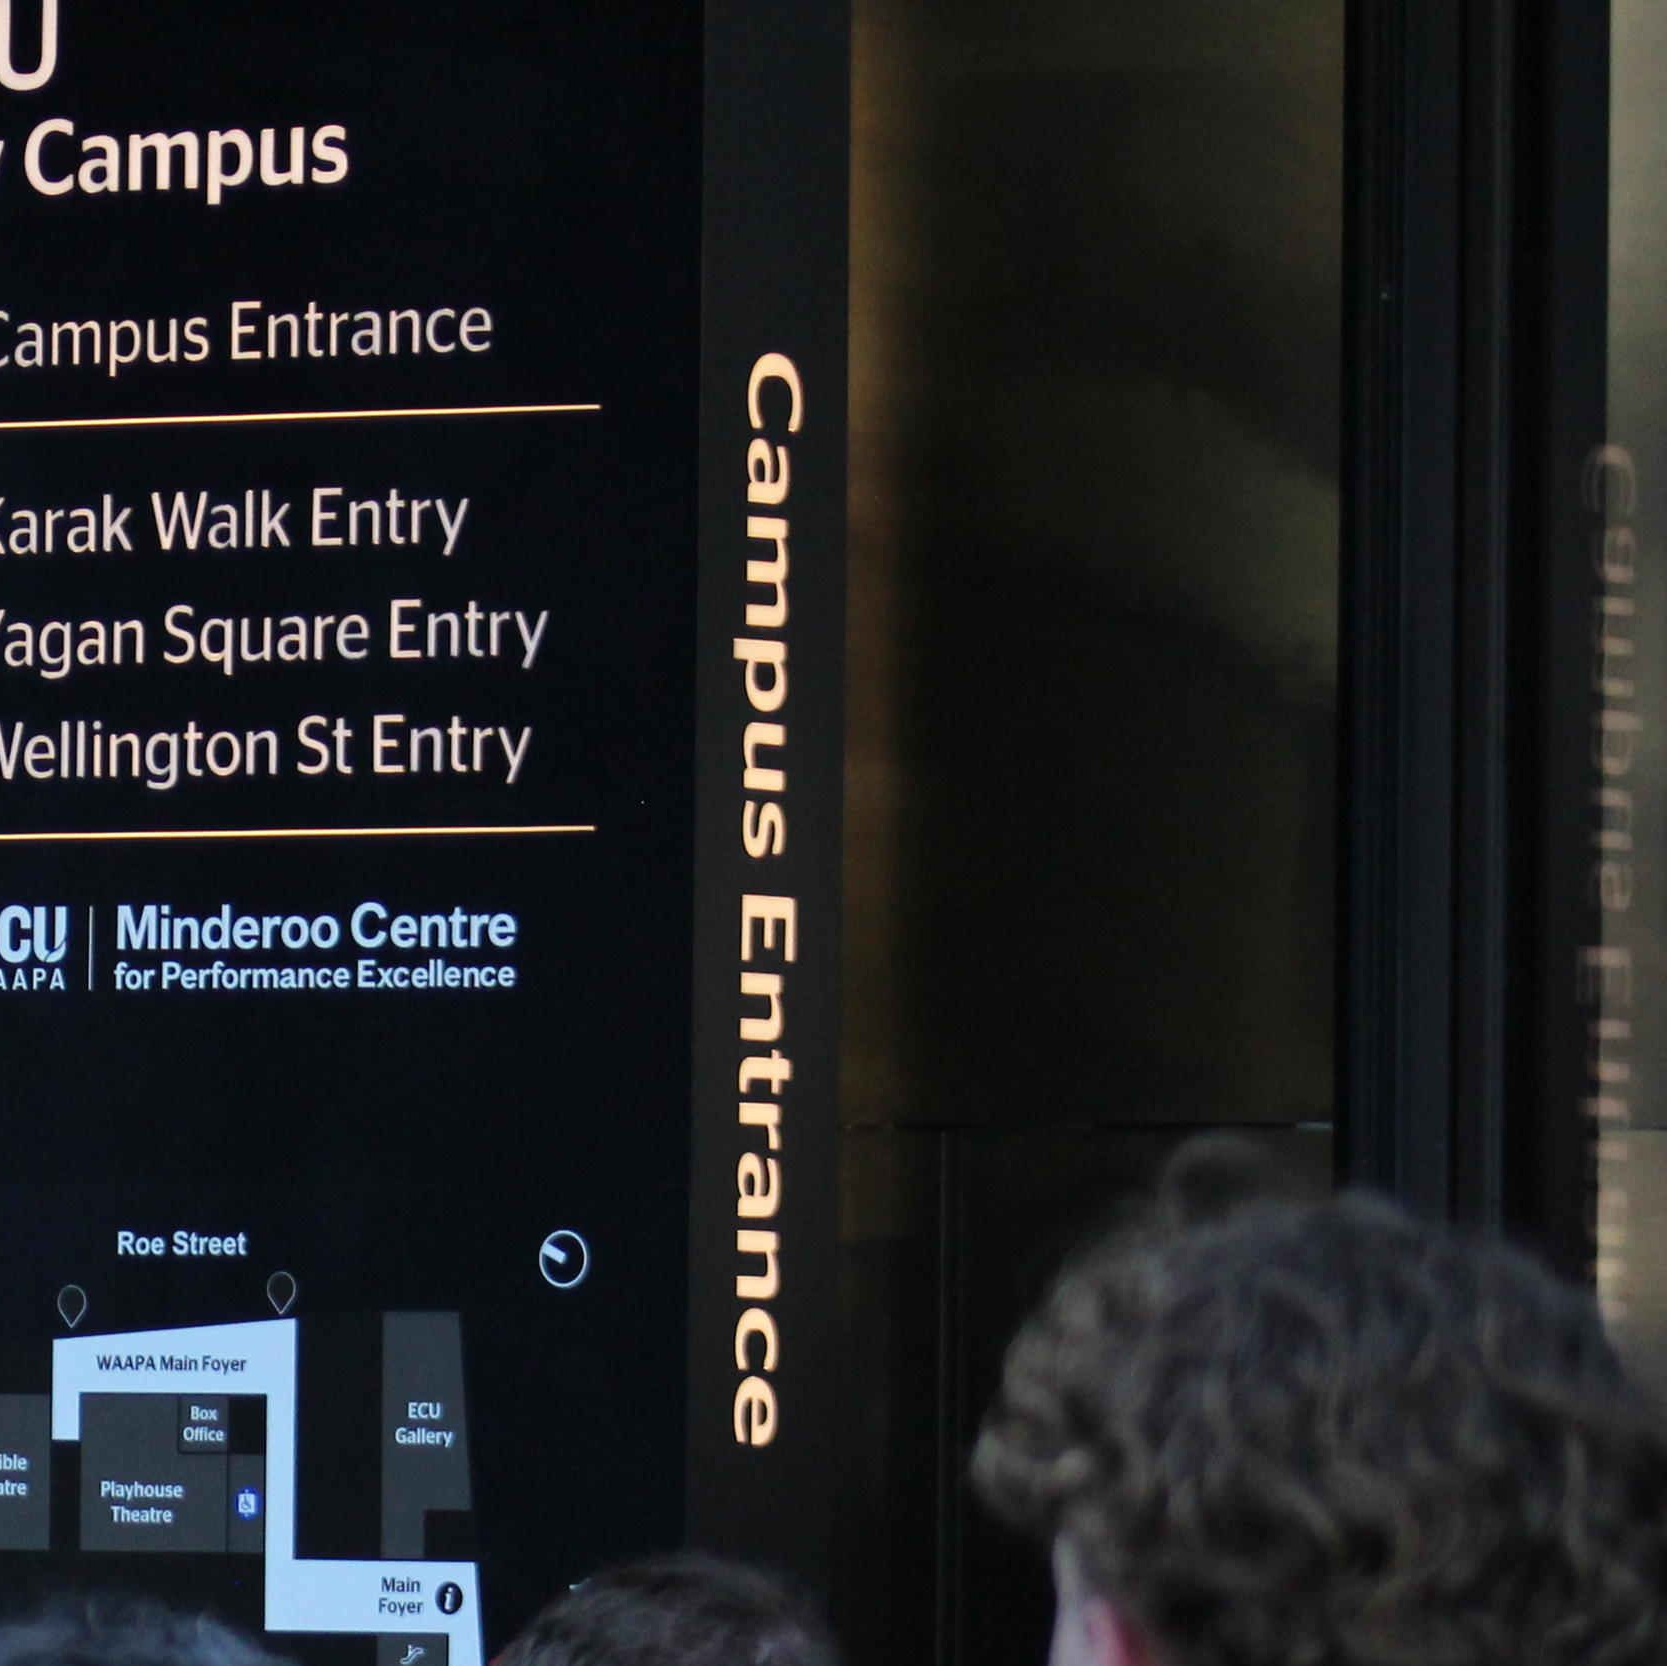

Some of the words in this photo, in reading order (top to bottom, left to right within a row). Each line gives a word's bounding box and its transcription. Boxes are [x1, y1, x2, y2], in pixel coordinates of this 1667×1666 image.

[25, 119, 348, 205] Campus
[231, 301, 491, 359] Entrance
[152, 490, 290, 550] Walk
[312, 488, 468, 555] Entry
[734, 353, 803, 858] Campus
[164, 605, 369, 675] Square
[390, 599, 547, 668] Entry
[298, 715, 352, 774] St
[374, 714, 531, 783] Entry
[117, 904, 340, 950] Minderoo
[351, 902, 517, 948] Centre
[114, 962, 155, 989] for
[162, 961, 351, 989] Performance
[358, 959, 515, 988] Excellence
[734, 895, 796, 1446] Entrance
[118, 1231, 165, 1255] Roe
[173, 1231, 246, 1255] Street
[97, 1355, 156, 1370] WAAPA
[160, 1356, 198, 1370] Main
[204, 1355, 246, 1374] Foyer
[191, 1406, 217, 1420] Box
[409, 1402, 441, 1419] ECU
[184, 1427, 224, 1441] Office
[396, 1427, 453, 1447] Gallery
[101, 1481, 183, 1500] Playhouse
[111, 1506, 173, 1523] Theatre
[382, 1577, 420, 1592] Main
[379, 1598, 423, 1616] Foyer
